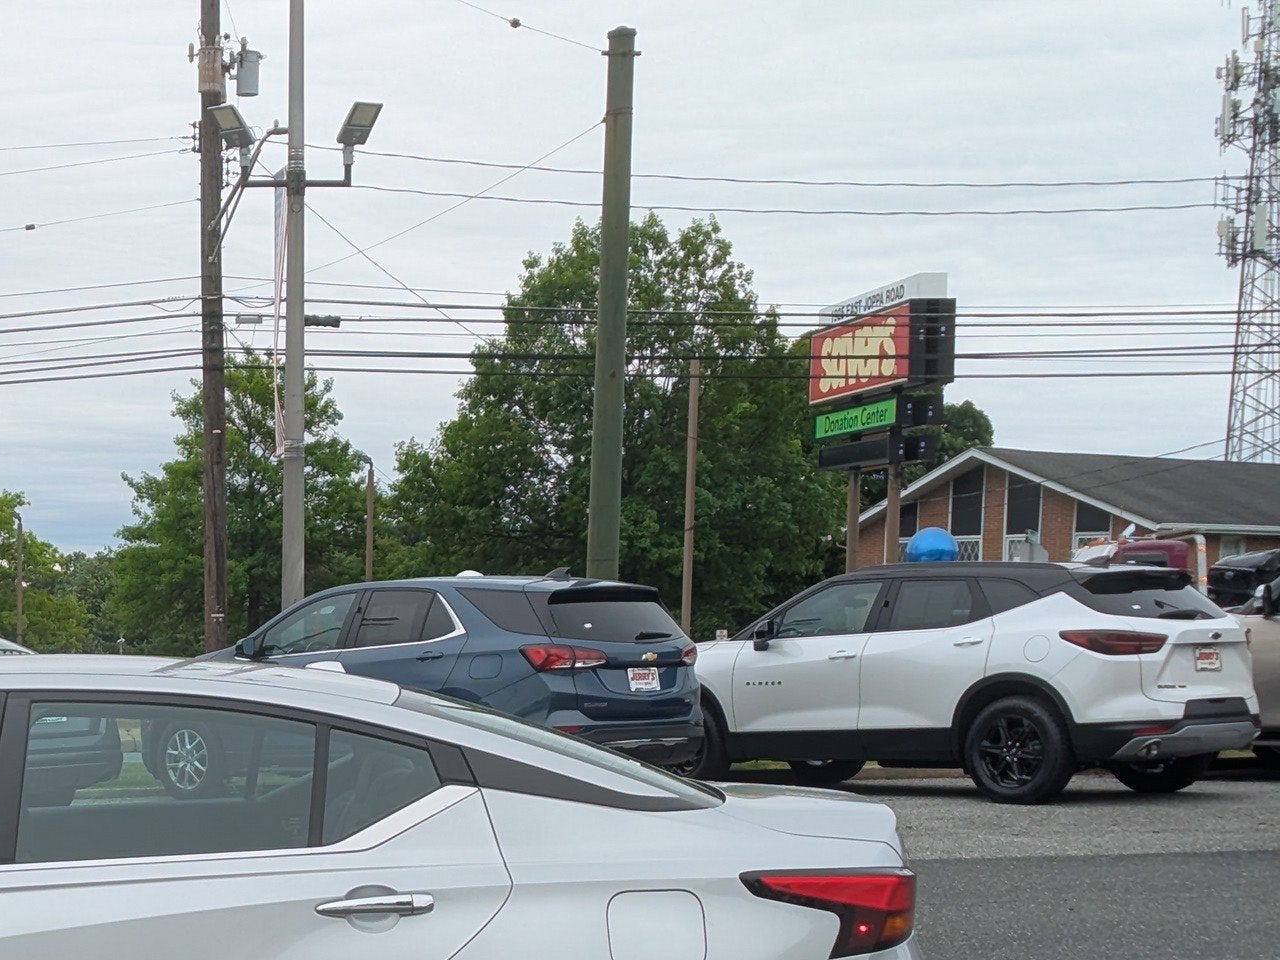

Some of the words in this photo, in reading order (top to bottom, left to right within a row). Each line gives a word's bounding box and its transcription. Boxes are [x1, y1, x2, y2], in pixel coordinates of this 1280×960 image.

[886, 284, 905, 302] ROAD
[825, 412, 859, 433] Donation
[861, 407, 888, 426] Center
